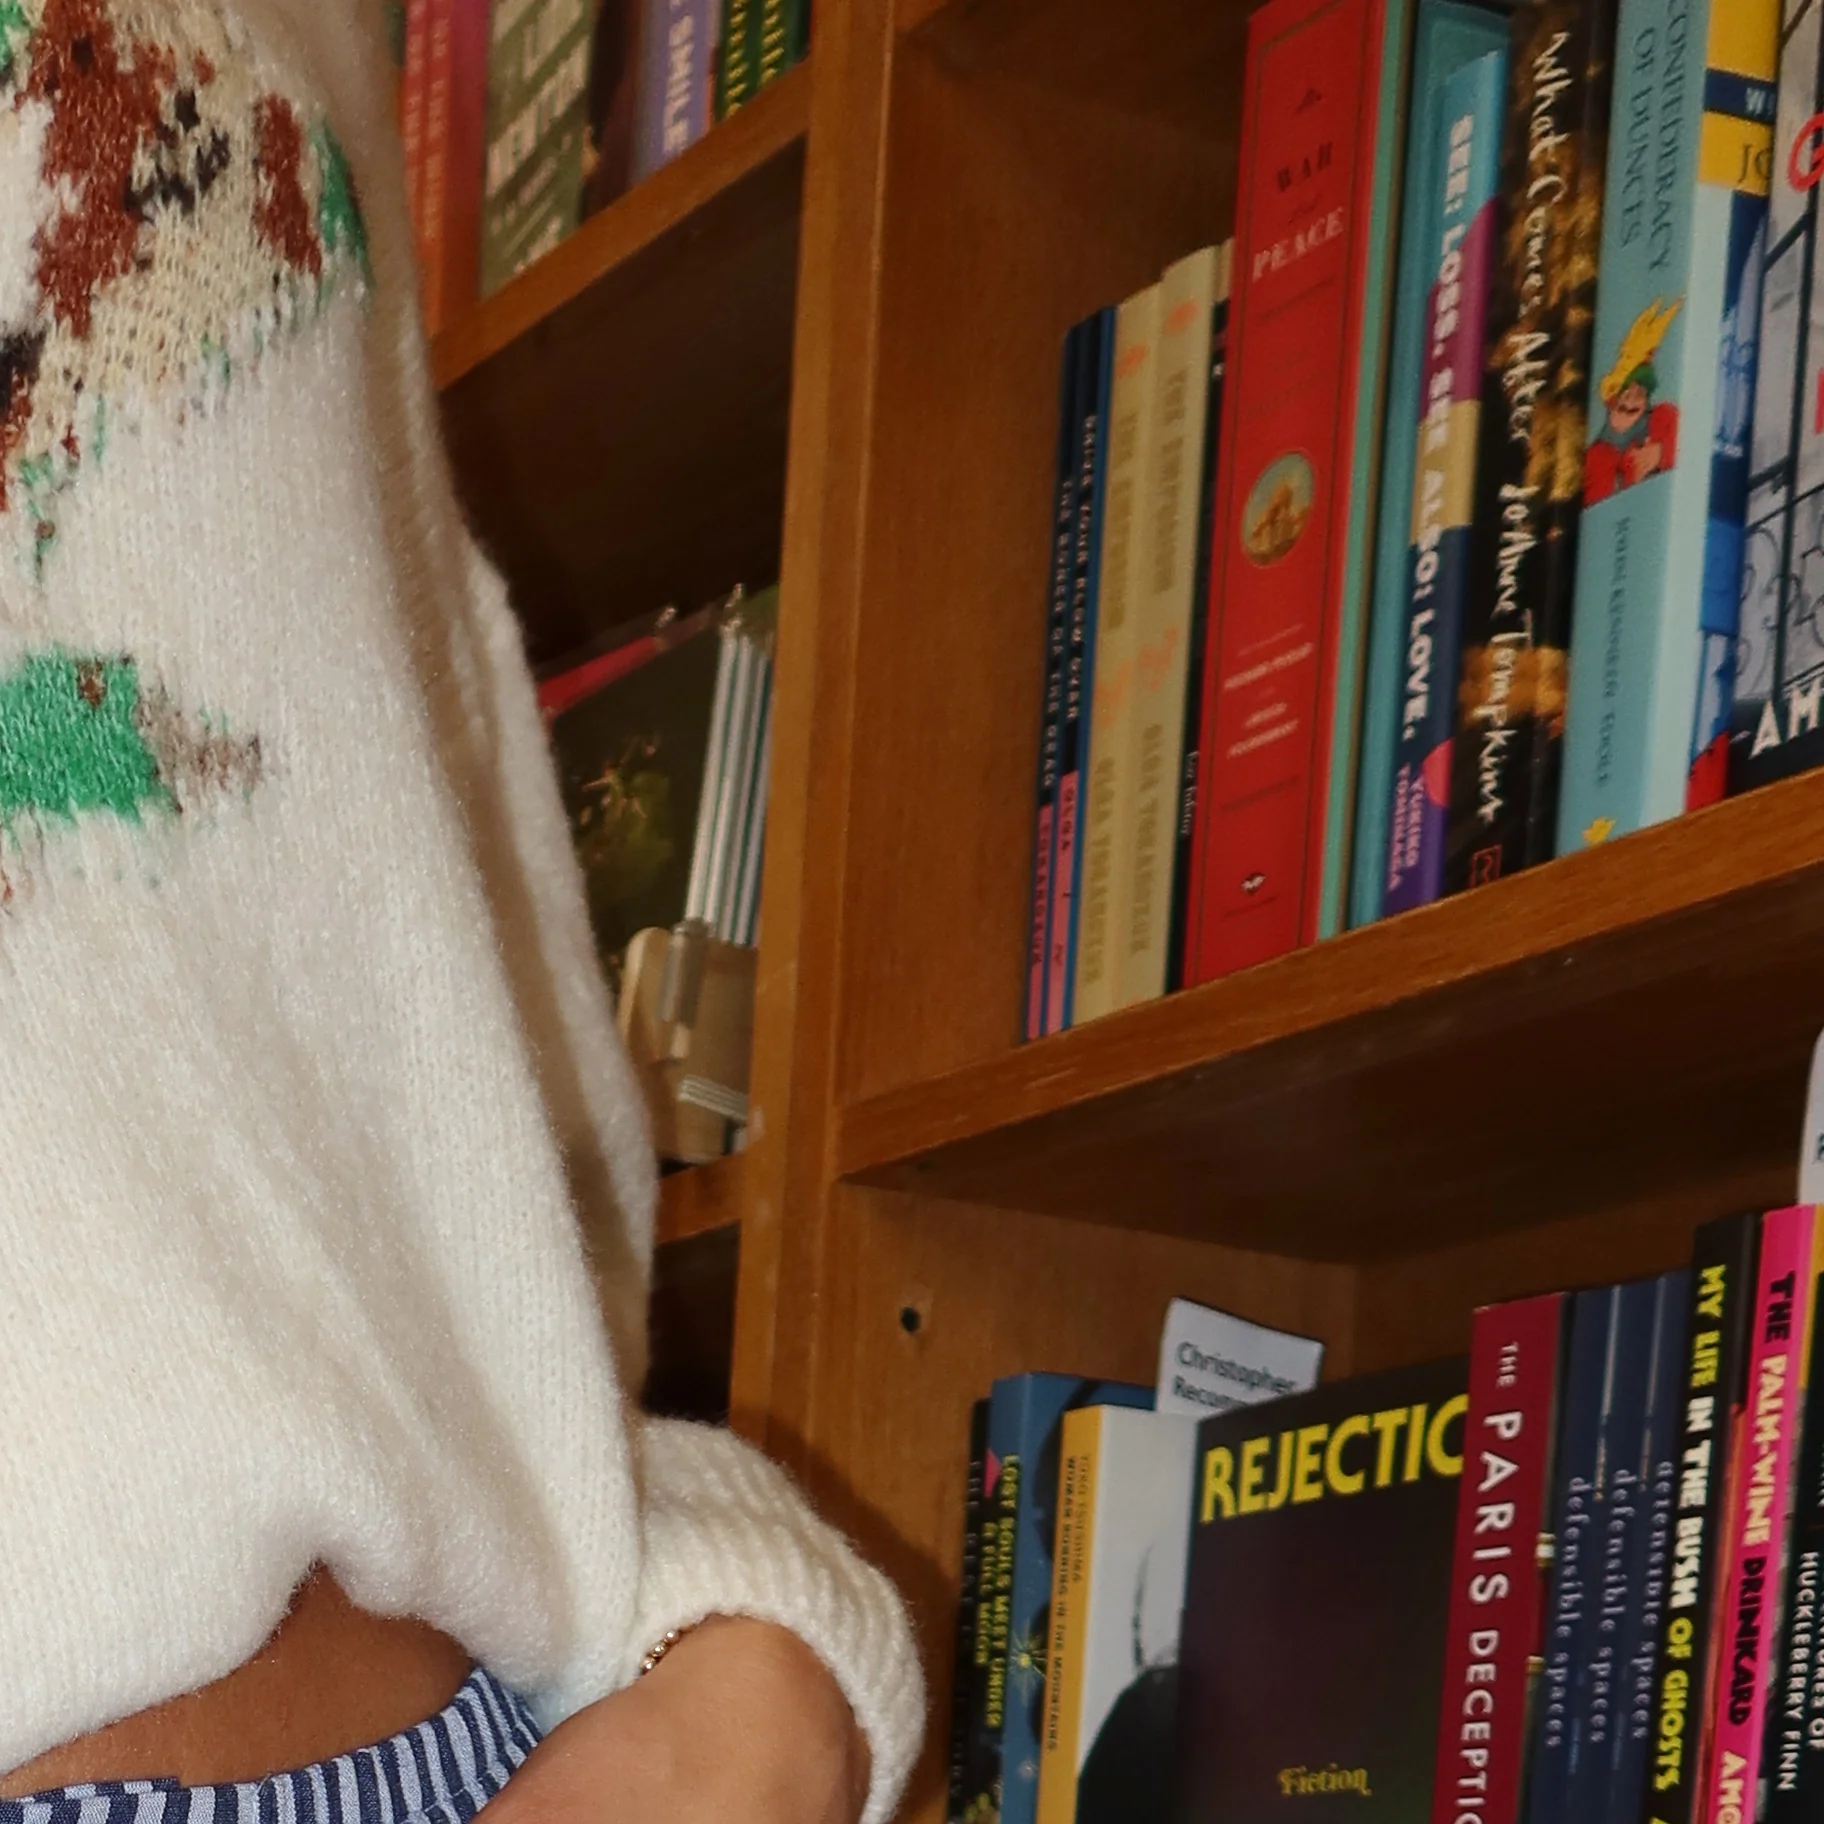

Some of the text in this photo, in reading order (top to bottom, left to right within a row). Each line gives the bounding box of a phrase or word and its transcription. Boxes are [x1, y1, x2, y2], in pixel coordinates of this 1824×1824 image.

[1528, 31, 1574, 162] What
[1252, 206, 1344, 283] PEACE
[1695, 1263, 1727, 1320] MY
[1764, 1269, 1797, 1345] THE
[1177, 1340, 1298, 1396] Christopher
[1495, 1341, 1519, 1388] THE
[1690, 1329, 1721, 1390] LIFE
[1685, 1395, 1716, 1434] IN
[1741, 1353, 1789, 1548] PALM-WINE
[1199, 1393, 1470, 1525] REJECTIO
[1677, 1438, 1712, 1510] THE
[1468, 1411, 1524, 1606] PARIS
[1587, 1468, 1638, 1744] defensible spaces
[1667, 1514, 1705, 1611] BUSH
[1545, 1477, 1594, 1748] defensible spaces
[1667, 1616, 1694, 1661] OF
[1728, 1553, 1769, 1727] DRINKARD
[1783, 1551, 1820, 1722] HUCKLEBERRY
[1630, 1640, 1656, 1740] spaces
[1653, 1668, 1690, 1792] GHOSTS
[1278, 1761, 1374, 1798] Fiction
[1776, 1729, 1802, 1791] FINN
